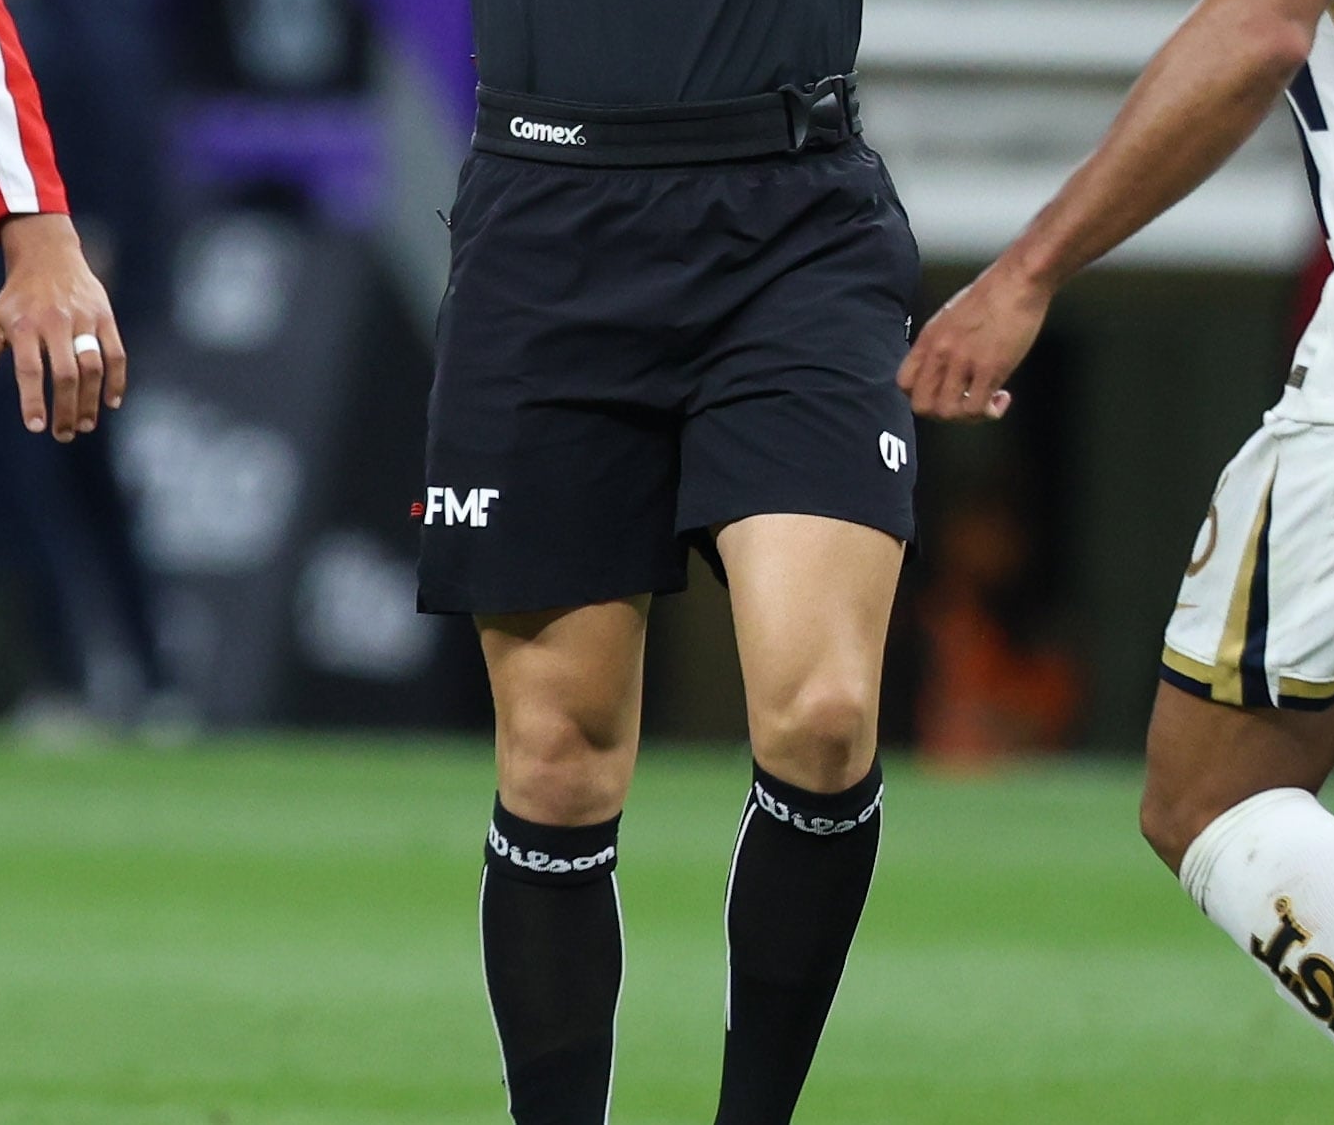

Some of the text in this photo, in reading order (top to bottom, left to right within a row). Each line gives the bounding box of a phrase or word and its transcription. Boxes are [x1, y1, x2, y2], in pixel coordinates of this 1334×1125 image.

[510, 116, 583, 144] Comex
[424, 486, 500, 528] FMF
[488, 819, 616, 873] Wilson
